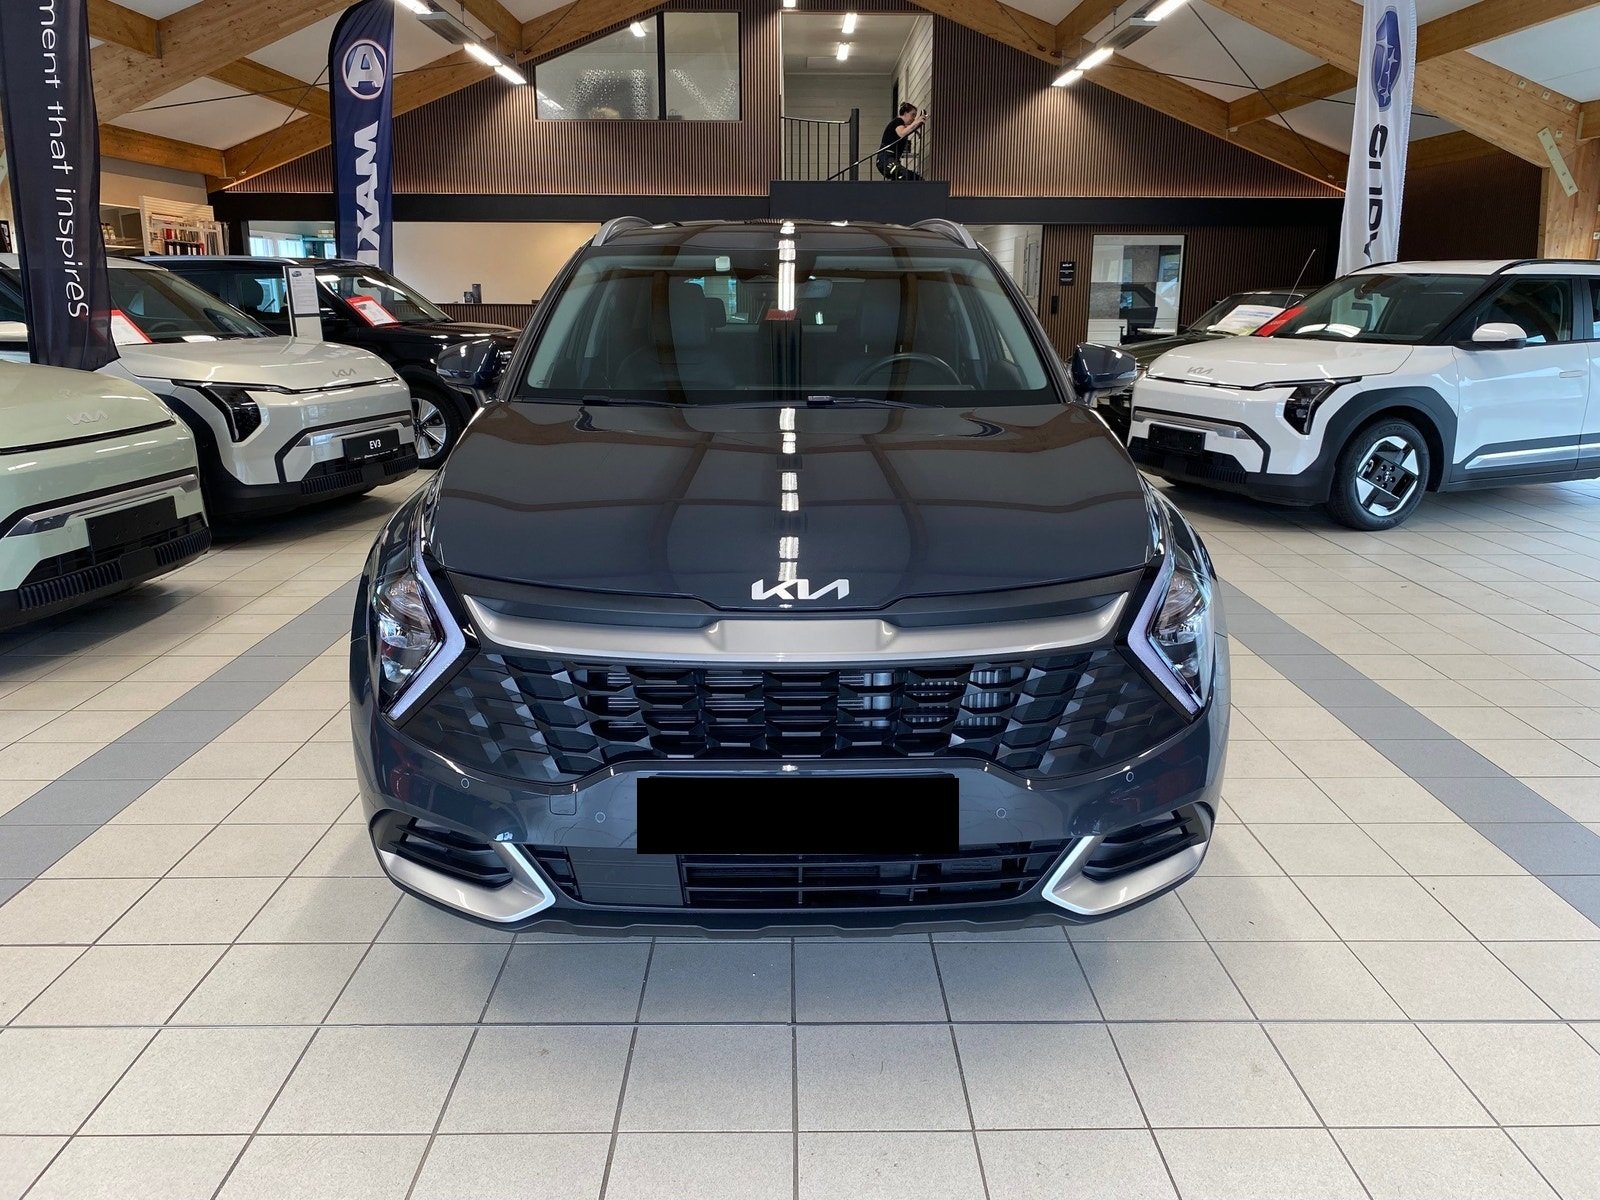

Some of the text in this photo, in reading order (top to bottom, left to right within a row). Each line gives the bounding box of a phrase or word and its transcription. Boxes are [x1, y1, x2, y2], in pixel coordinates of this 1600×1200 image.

[47, 101, 74, 175] that
[54, 188, 89, 318] inspires
[369, 439, 381, 449] EV3
[751, 578, 850, 600] KIA
